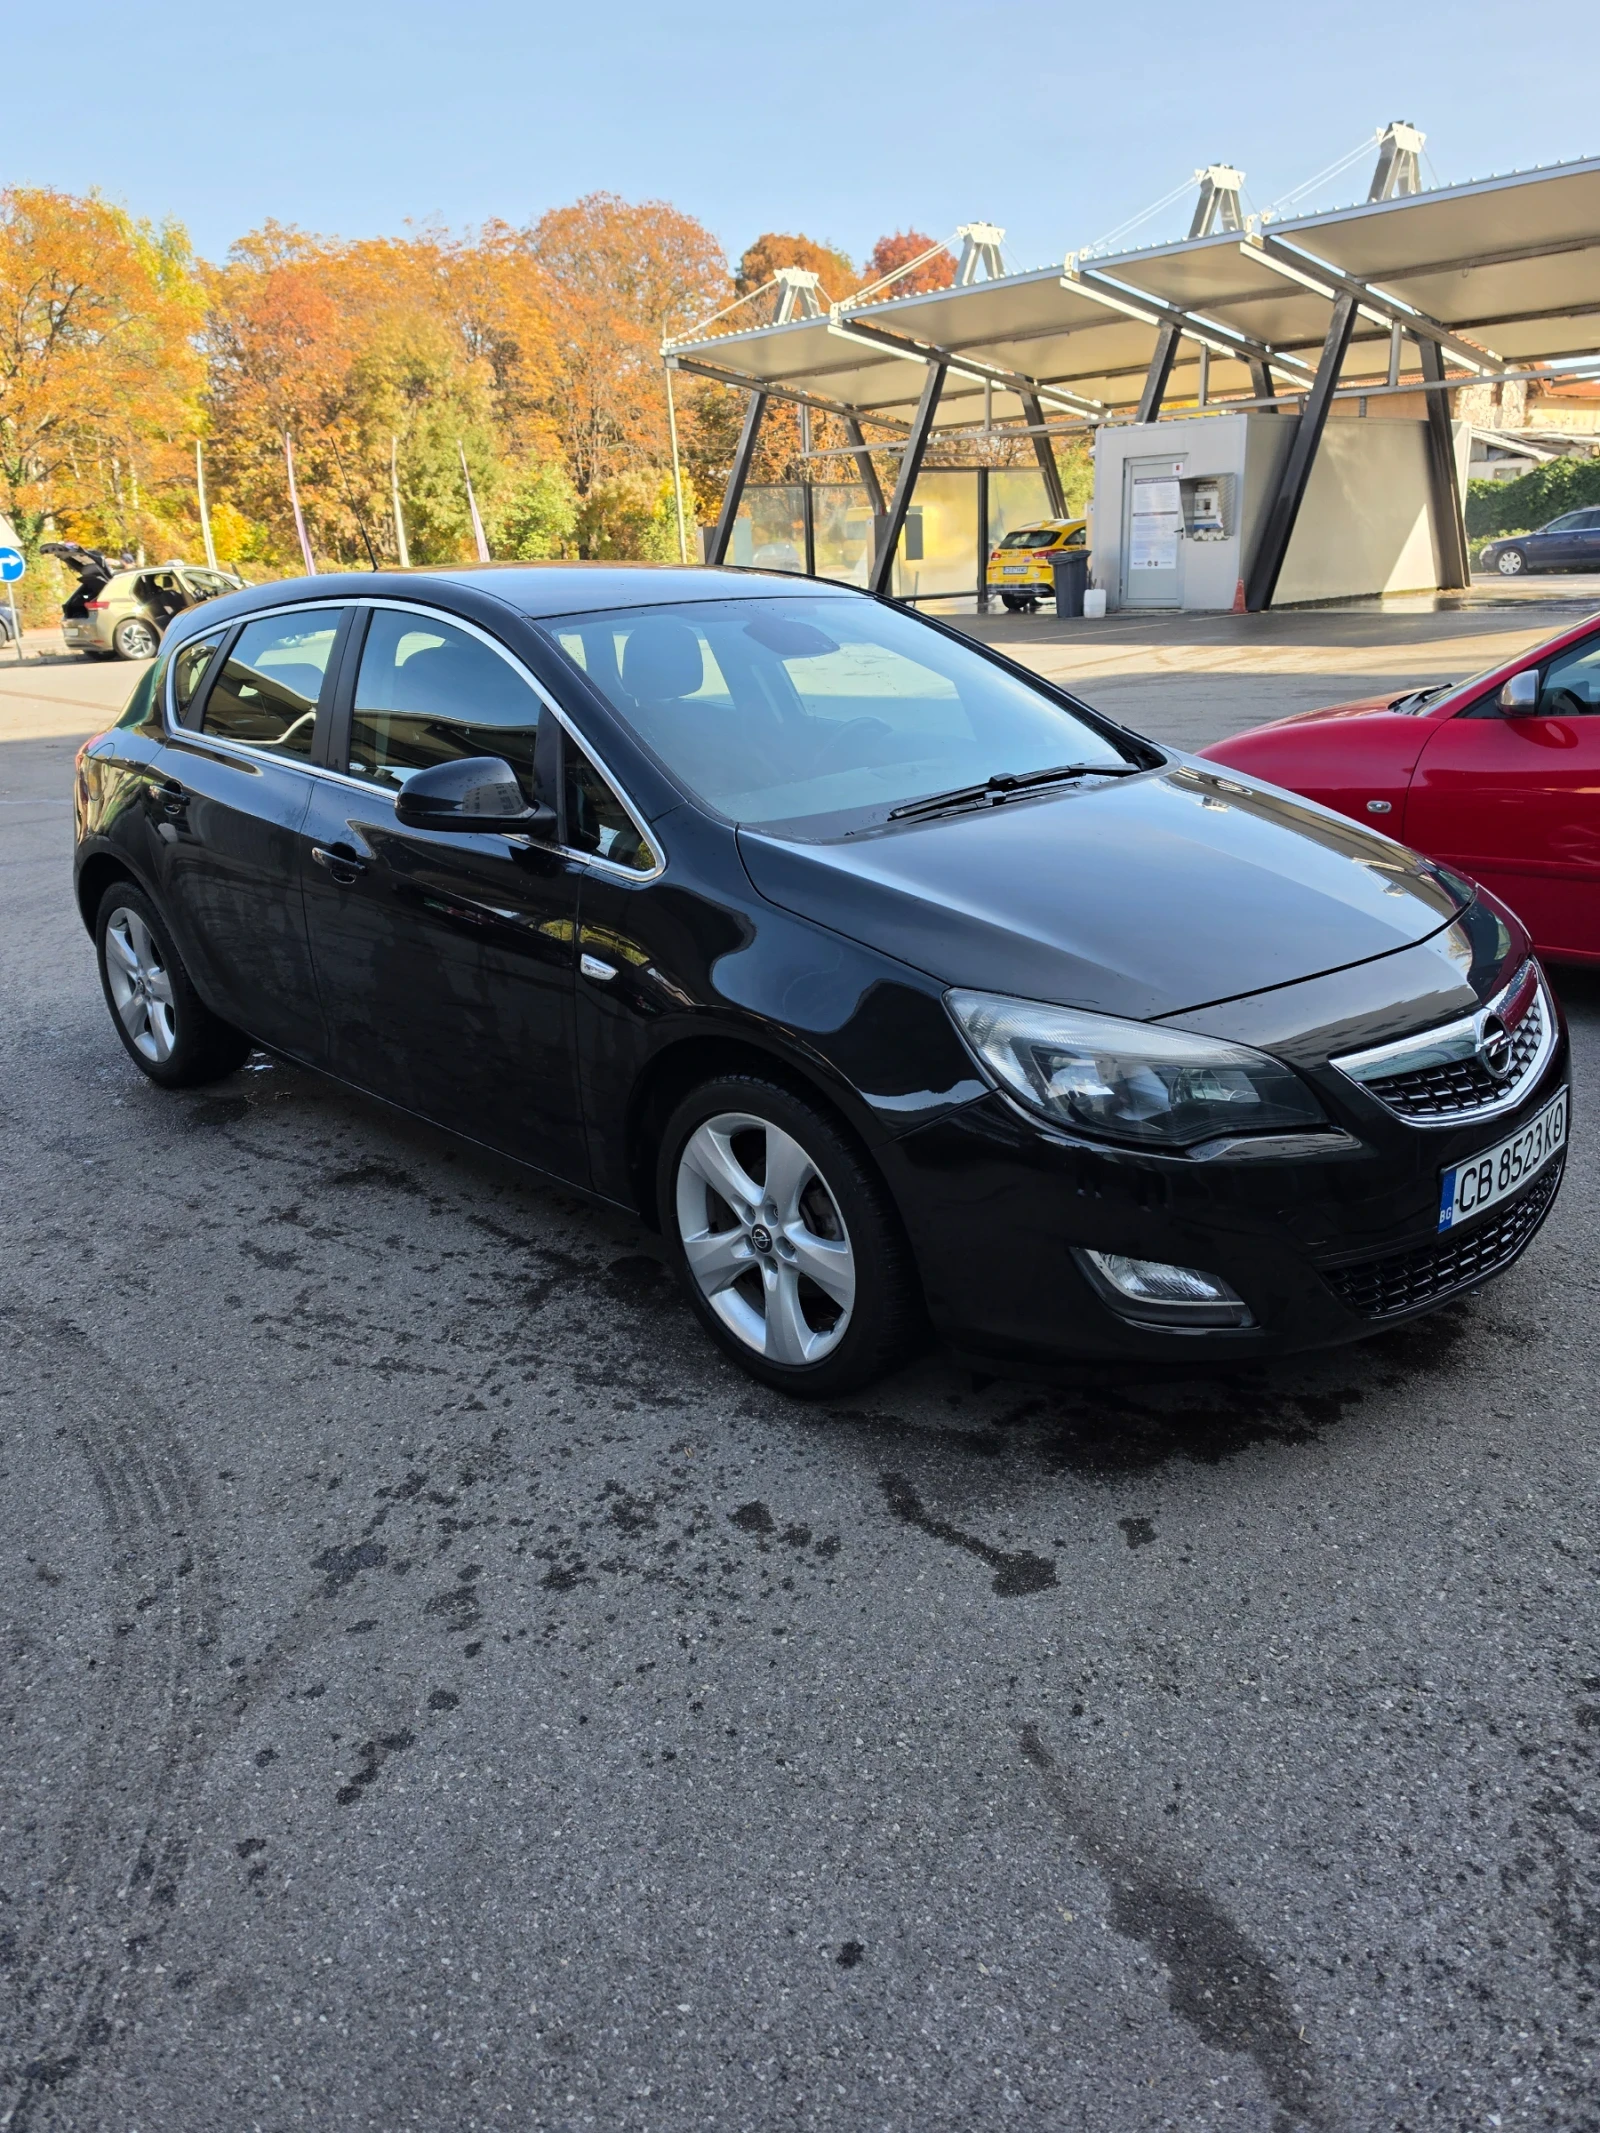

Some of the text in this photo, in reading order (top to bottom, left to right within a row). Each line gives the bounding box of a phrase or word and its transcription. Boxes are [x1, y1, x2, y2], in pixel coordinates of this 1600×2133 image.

[1460, 1159, 1492, 1212] CB
[1498, 1122, 1542, 1191] 8523
[1439, 1206, 1452, 1223] BG
